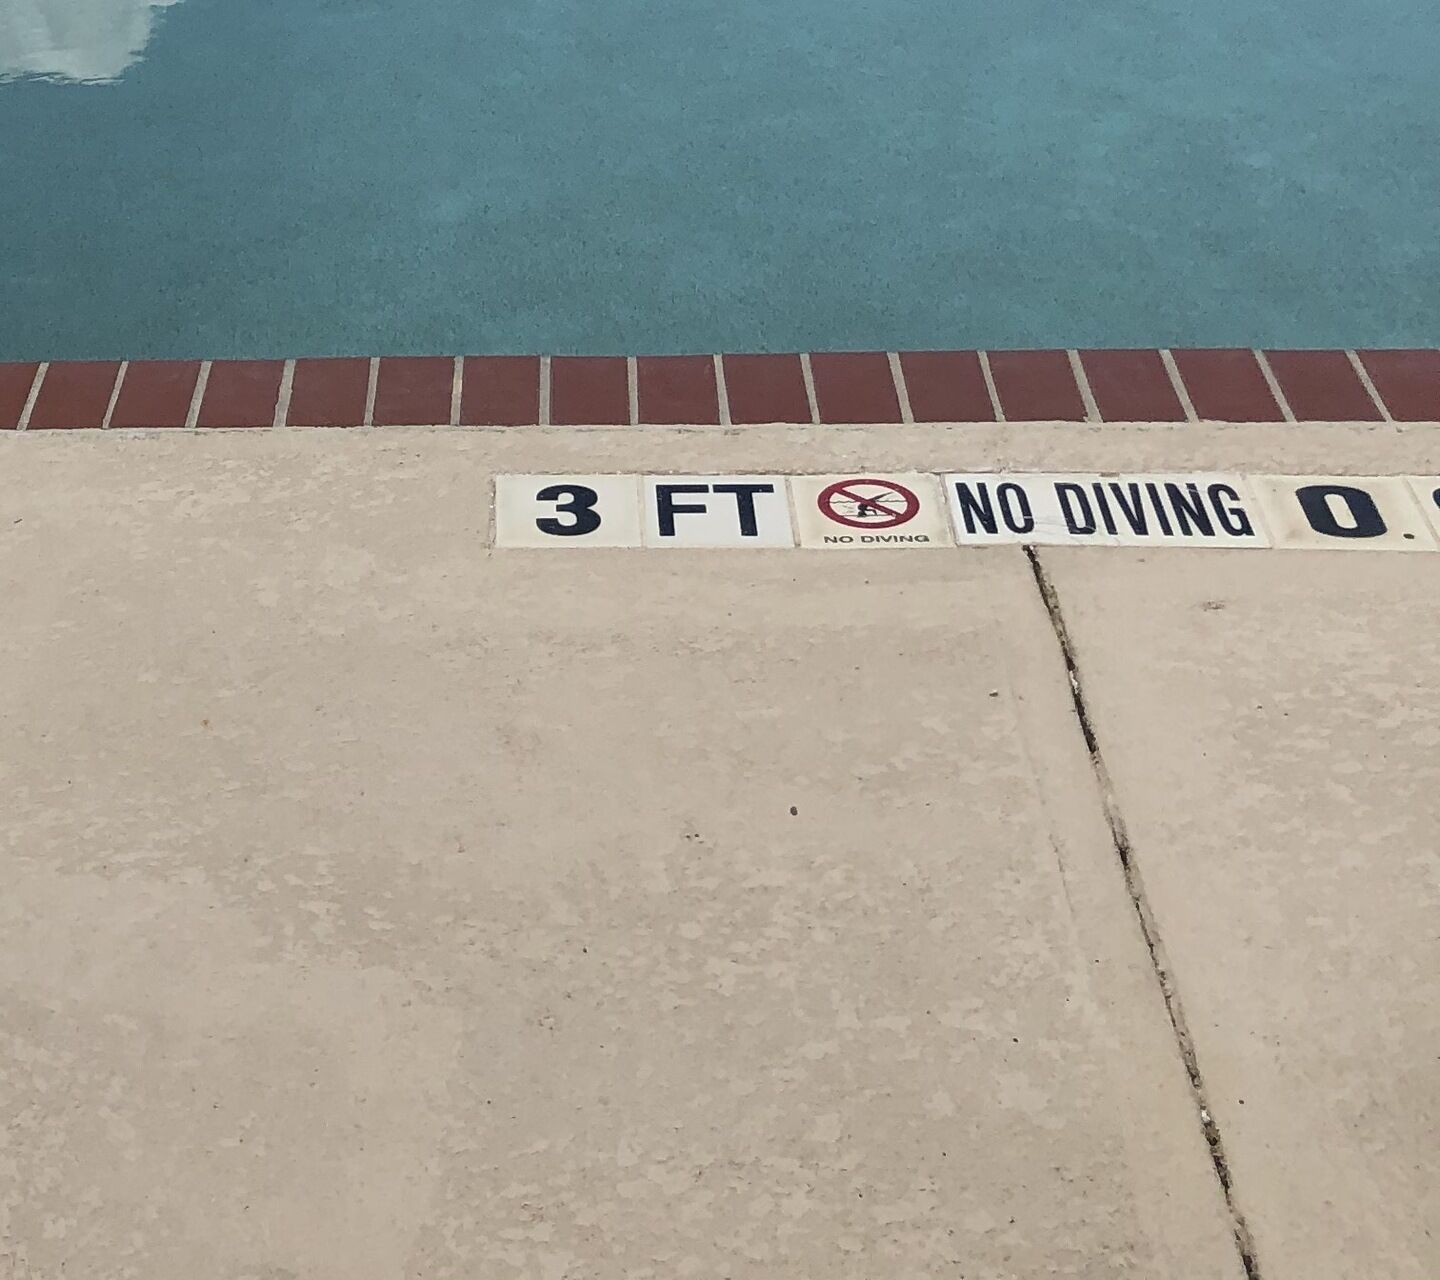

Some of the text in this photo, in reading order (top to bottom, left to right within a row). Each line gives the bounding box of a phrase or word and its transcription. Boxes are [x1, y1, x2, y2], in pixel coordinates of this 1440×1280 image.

[536, 484, 602, 536] 3
[655, 484, 775, 537] FT
[954, 482, 1035, 535] NO
[1053, 482, 1256, 537] DIVING
[824, 535, 930, 544] NO DIVING
